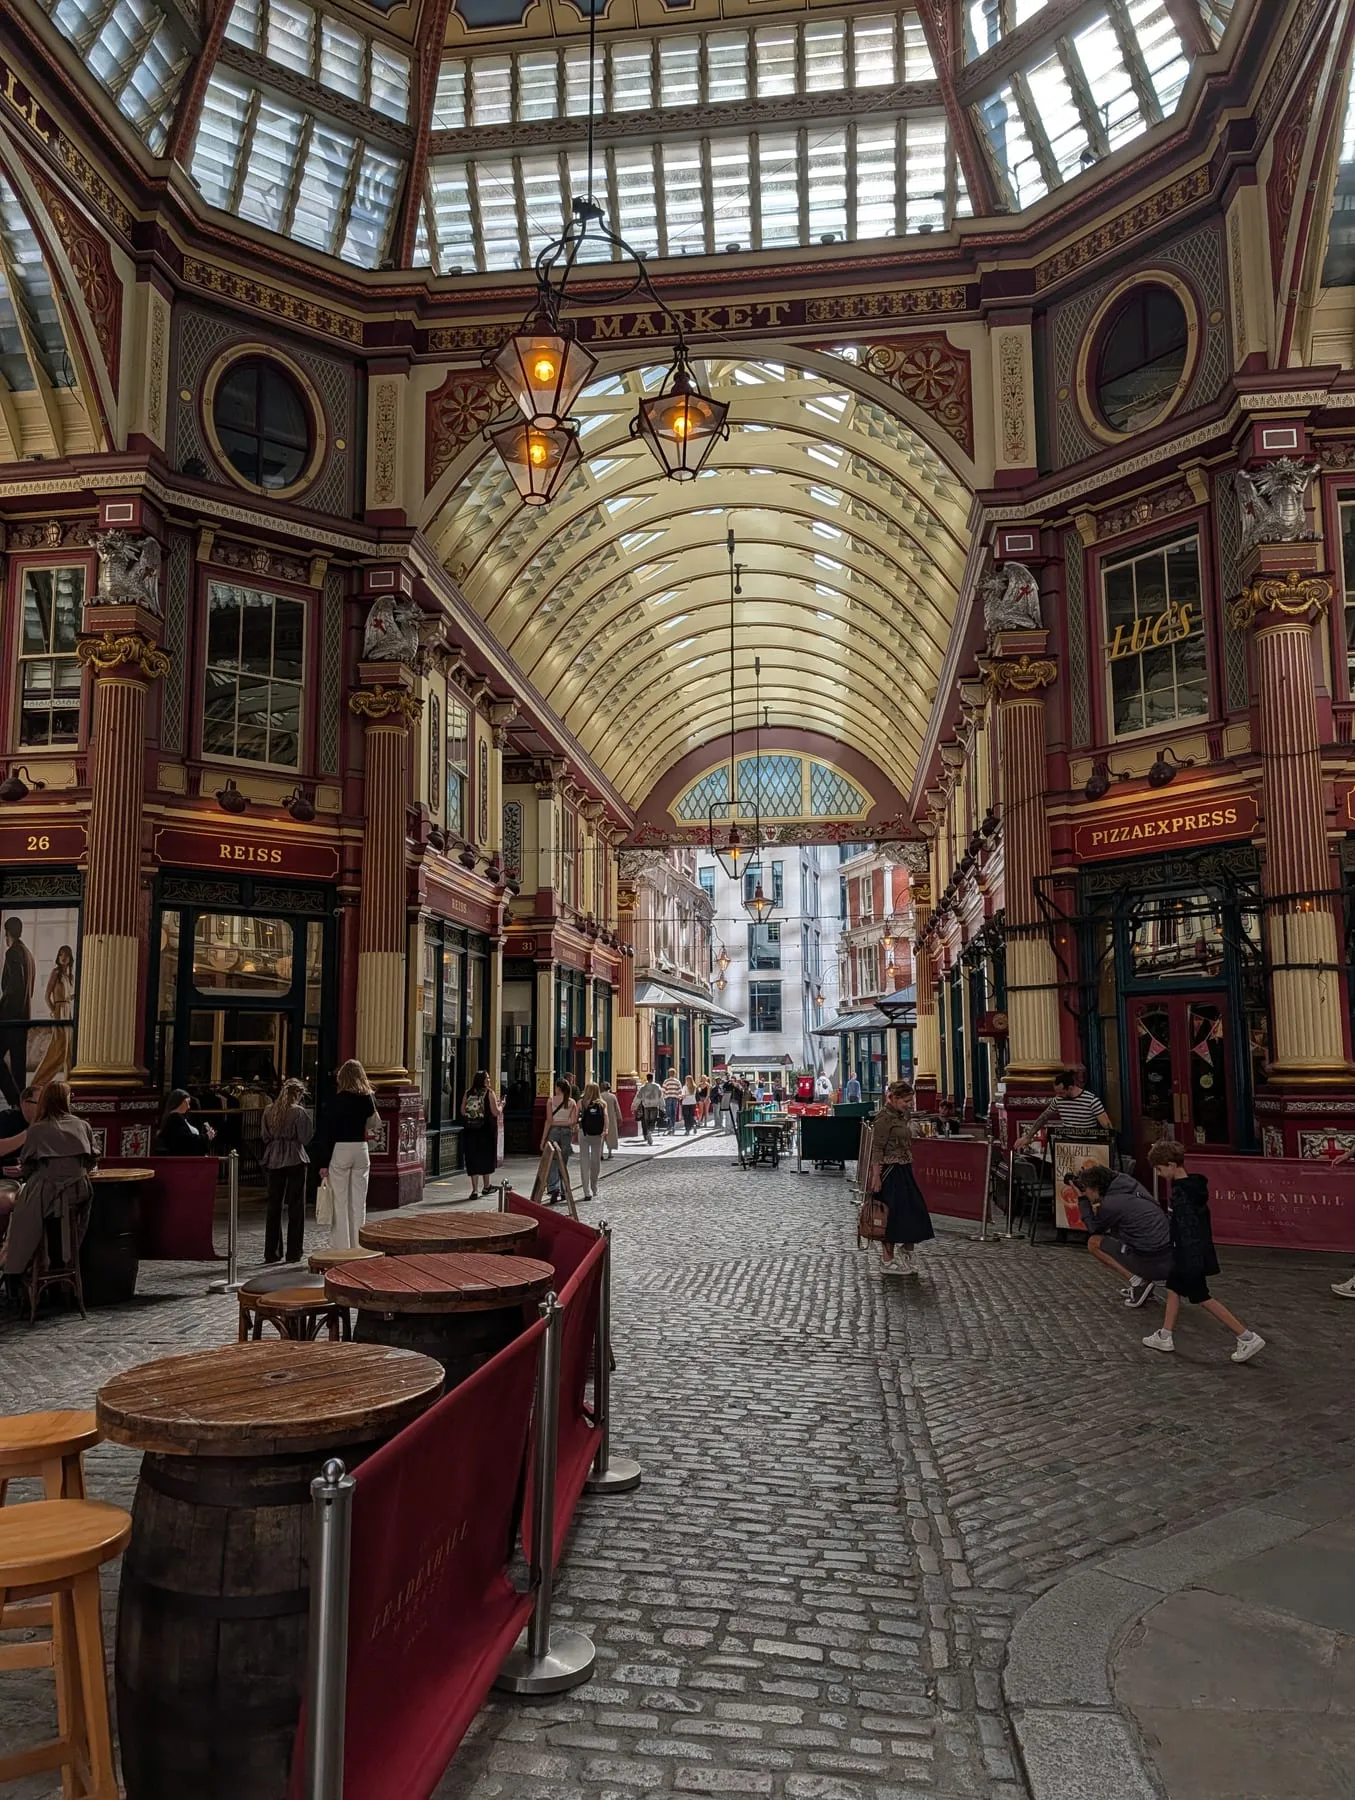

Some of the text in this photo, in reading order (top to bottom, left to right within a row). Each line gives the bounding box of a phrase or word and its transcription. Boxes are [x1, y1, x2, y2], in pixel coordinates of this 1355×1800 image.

[0, 68, 50, 144] LL
[591, 302, 791, 340] MARKET
[1110, 601, 1193, 659] LUC'S
[1092, 808, 1238, 846] PIZZAEXPRESS
[27, 836, 50, 850] 26
[219, 844, 282, 863] REISS
[451, 898, 468, 914] REISS
[522, 942, 533, 951] 31
[1056, 1144, 1092, 1157] DOUBLE
[1057, 1156, 1075, 1167] THE
[1215, 1189, 1345, 1207] LEADENHALL
